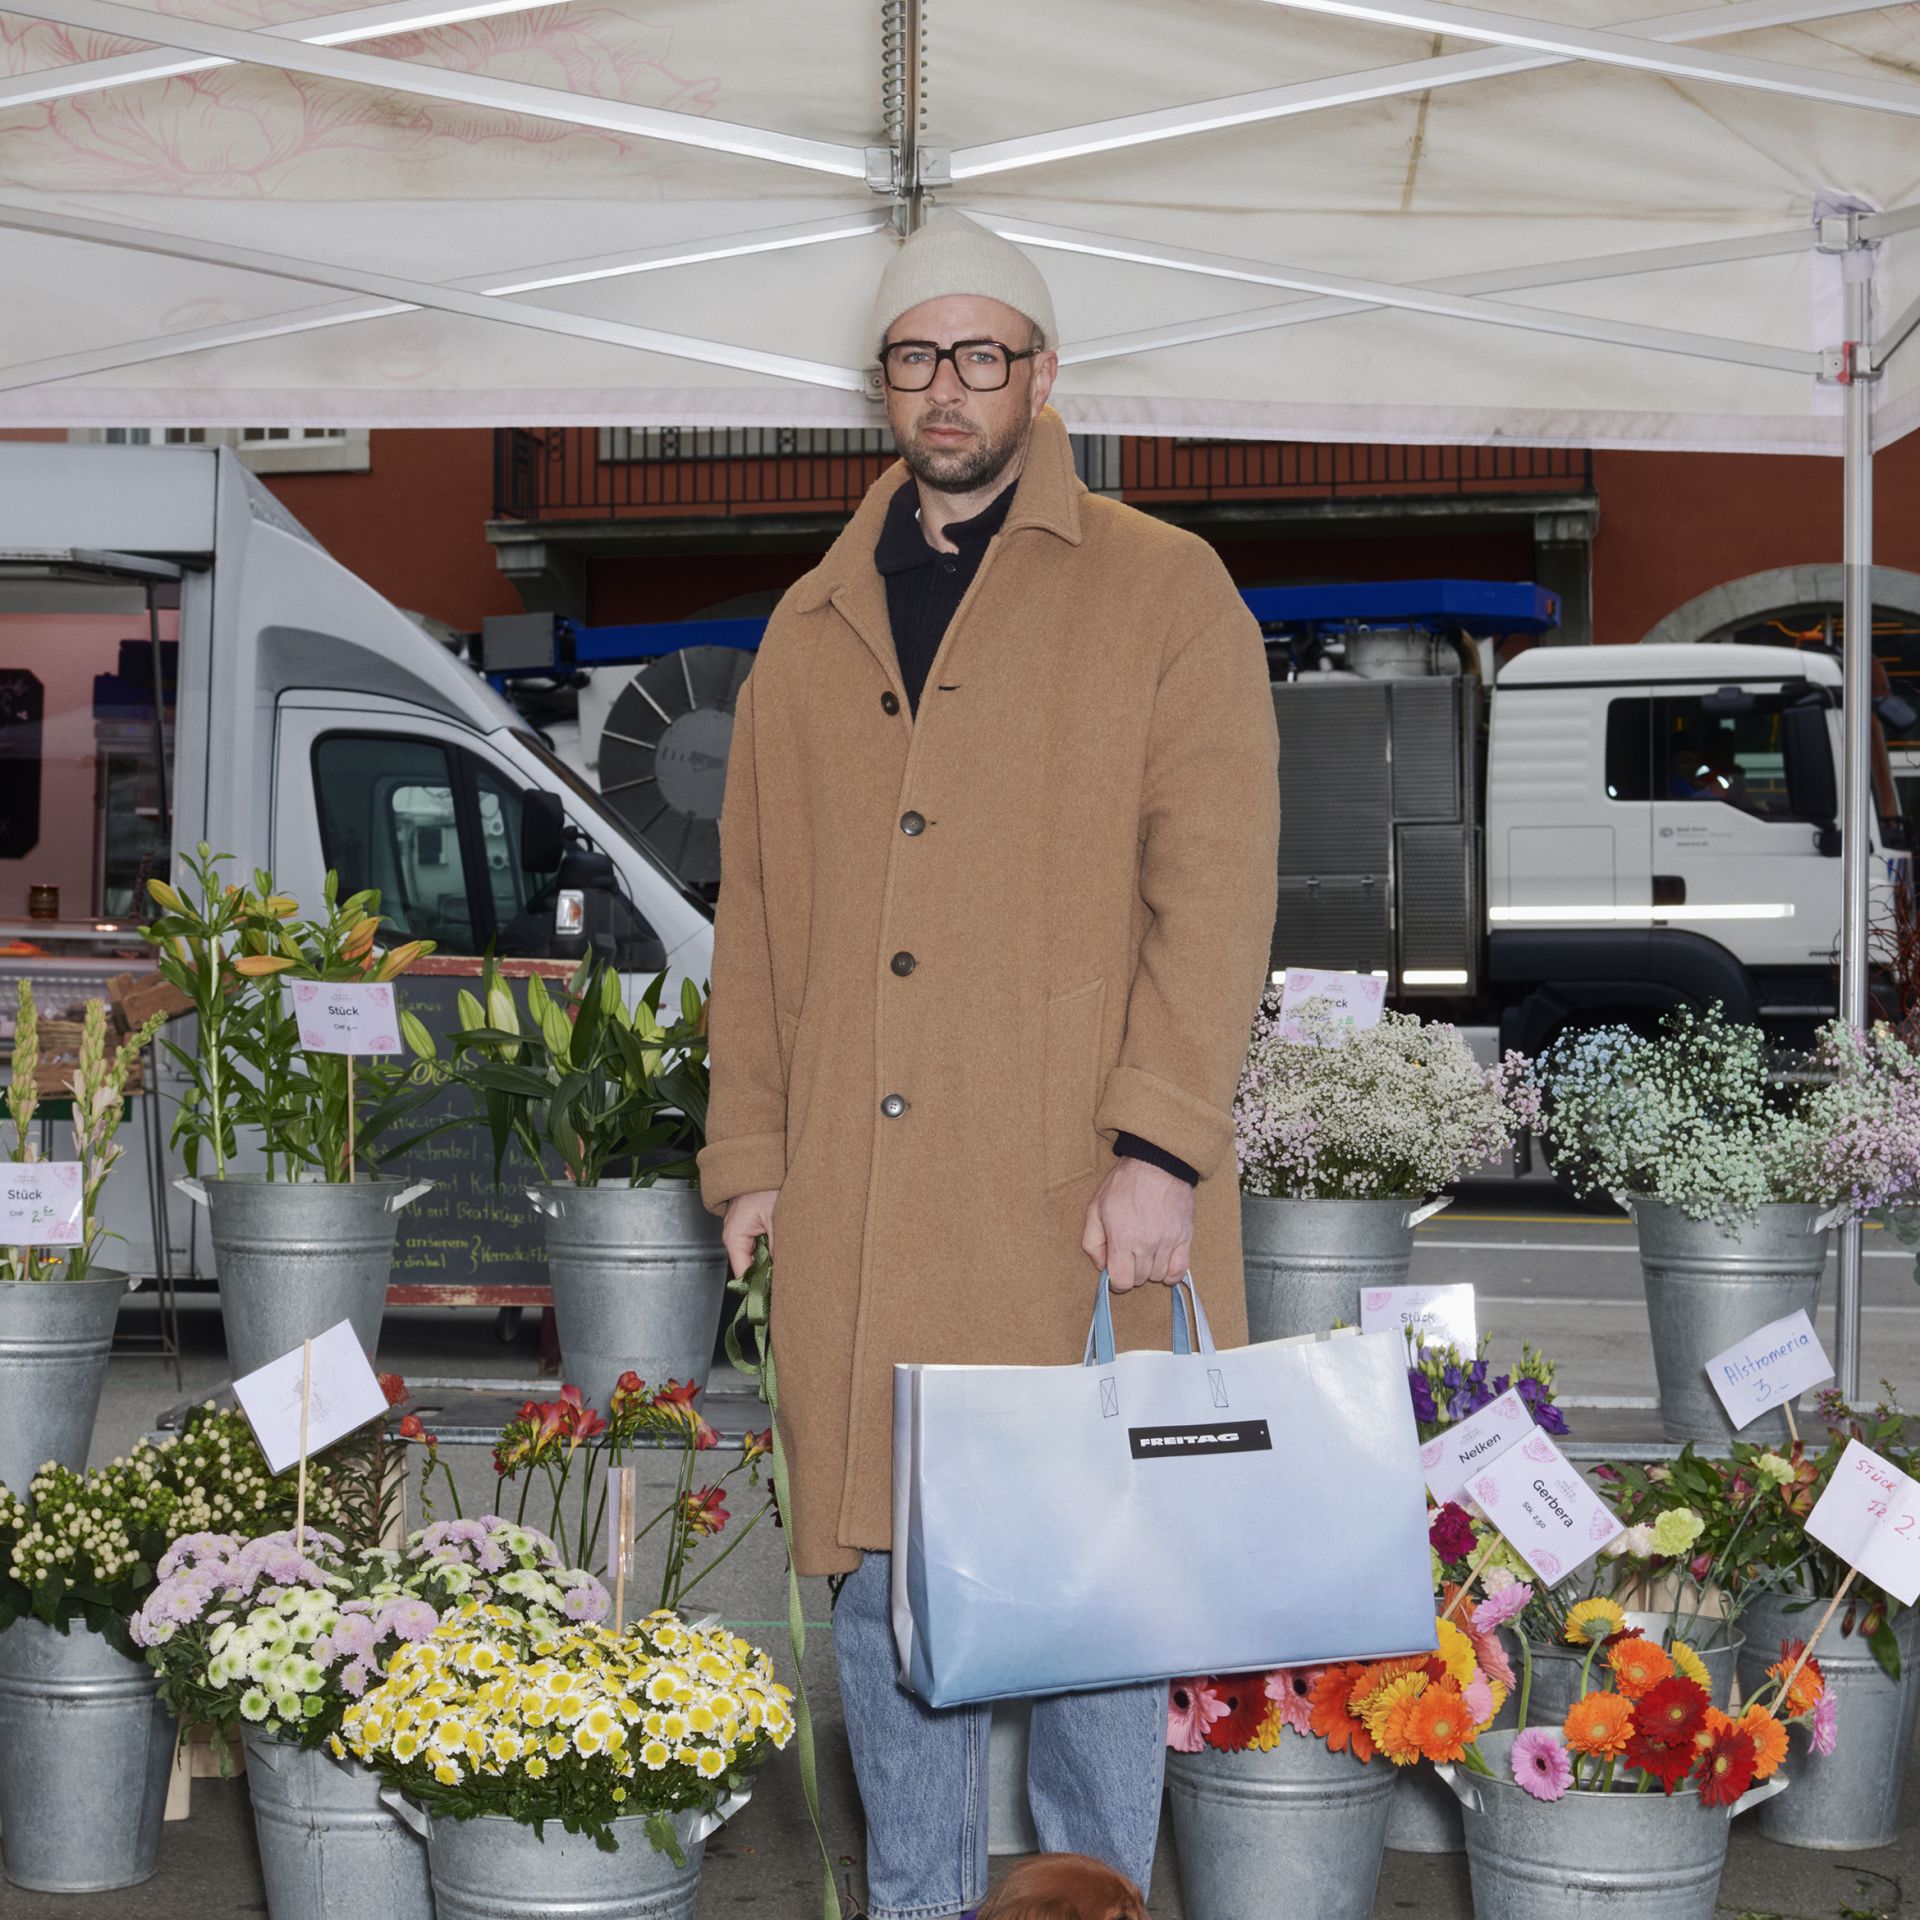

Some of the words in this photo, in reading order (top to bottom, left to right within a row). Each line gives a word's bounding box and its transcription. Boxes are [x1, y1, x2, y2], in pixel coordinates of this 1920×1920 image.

[328, 1005, 359, 1016] Stück
[7, 1189, 42, 1200] Stück
[1723, 1332, 1810, 1387] Alstromeria
[1140, 1432, 1240, 1448] FREITAG
[1458, 1433, 1502, 1464] Nelken
[1532, 1479, 1574, 1529] Gerbera
